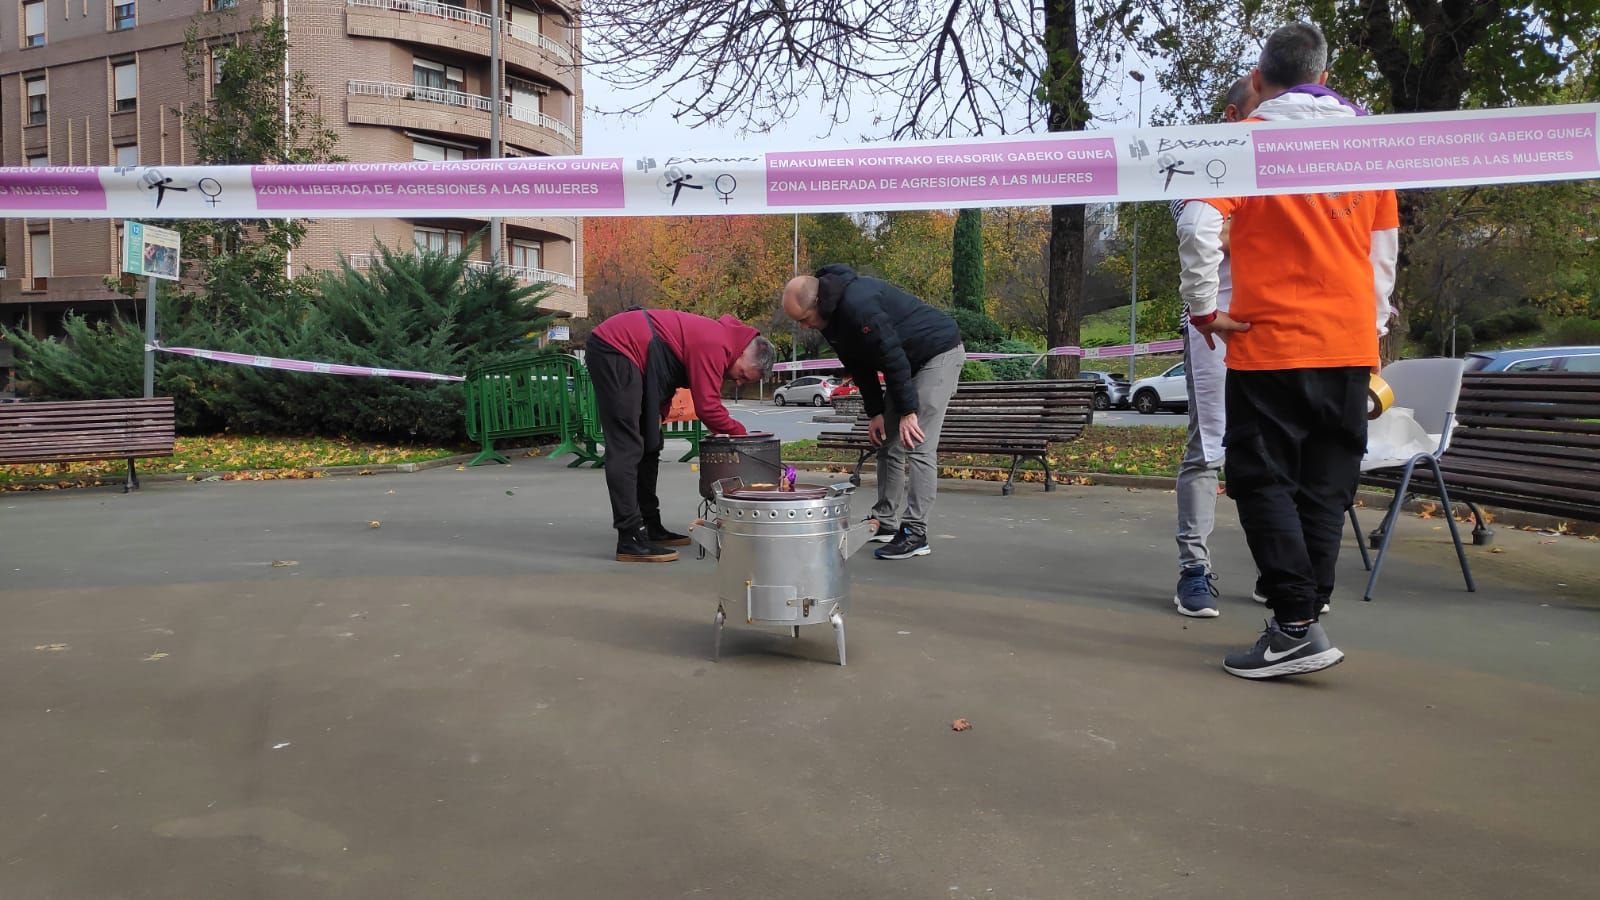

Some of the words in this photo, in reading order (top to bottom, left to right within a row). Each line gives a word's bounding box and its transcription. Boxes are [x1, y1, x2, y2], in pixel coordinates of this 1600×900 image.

[1257, 139, 1339, 153] EMAKUMEEN
[1343, 136, 1415, 149] KONTRAKO
[1419, 133, 1484, 146] ERASORIK
[1488, 130, 1543, 142] GABEKO
[1547, 127, 1593, 139] GUNEA
[432, 162, 504, 171] ERASORIK
[508, 161, 567, 171] GABEKO
[571, 161, 619, 170] GUNEA
[770, 158, 854, 168] EMAKUMEEN
[858, 155, 933, 166] KONTRAKO
[936, 153, 1004, 164] ERASORIK
[1007, 151, 1064, 162] GABEKO
[1067, 149, 1113, 160] GUNEA
[1258, 164, 1295, 176] ZONA
[1298, 161, 1363, 174] LIBERADA
[1366, 160, 1384, 170] DE
[1386, 156, 1469, 170] AGRESIONES
[1472, 155, 1482, 166] A
[1484, 154, 1509, 165] LAS
[1513, 151, 1574, 163] MUJERES
[258, 184, 298, 195] ZONA
[300, 184, 372, 195] LIBERADA
[375, 184, 394, 194] DE
[397, 184, 487, 195] AGRESIONES
[490, 184, 500, 194] A
[503, 184, 530, 194] LAS
[534, 183, 599, 194] MUJERES
[770, 180, 807, 192] ZONA
[810, 179, 877, 191] LIBERADA
[880, 178, 898, 189] DE
[901, 176, 986, 189] AGRESIONES
[989, 176, 999, 186] A
[1002, 174, 1028, 185] LAS
[1031, 172, 1093, 184] MUJERES
